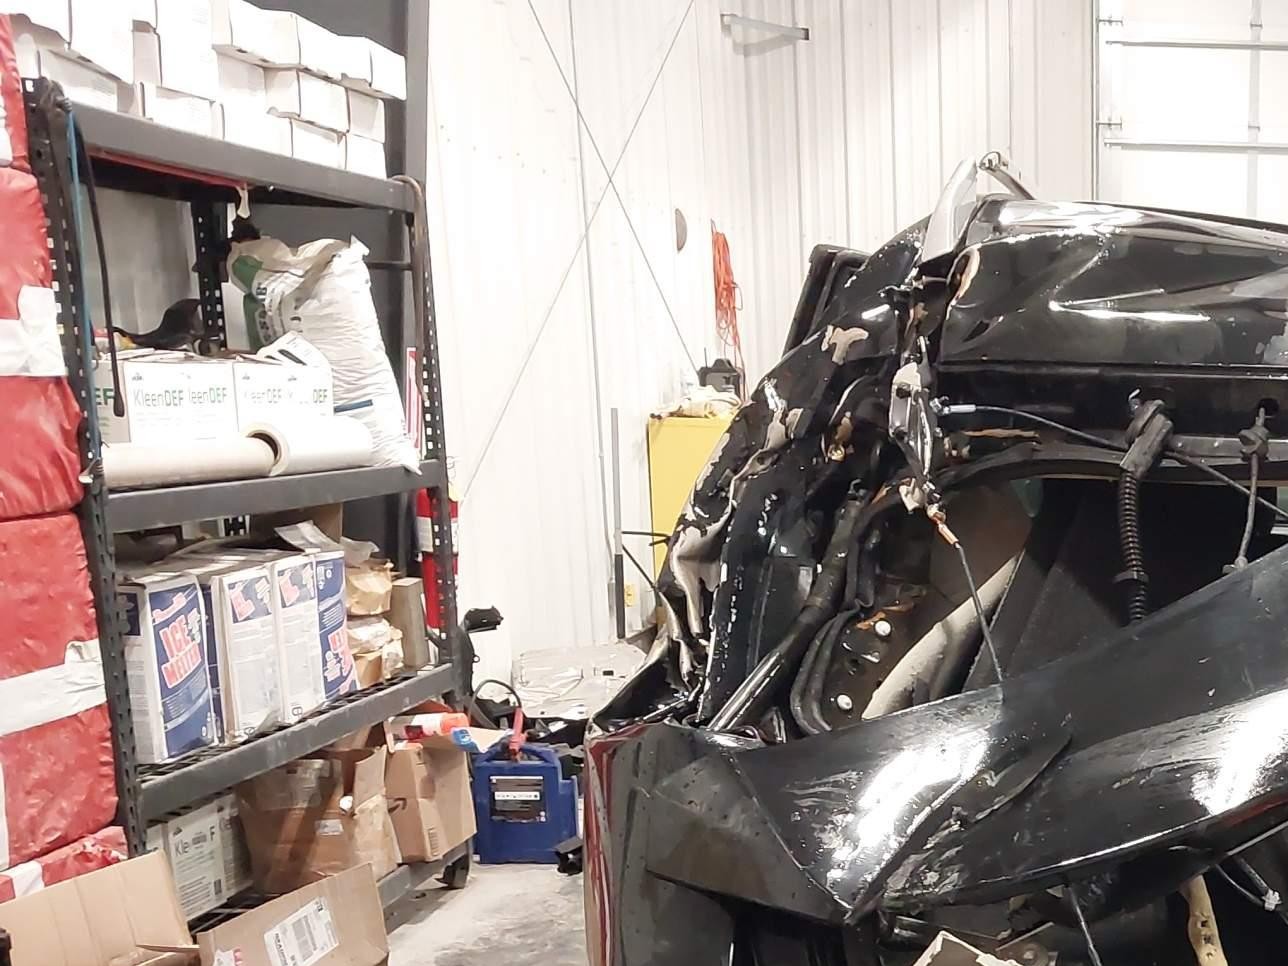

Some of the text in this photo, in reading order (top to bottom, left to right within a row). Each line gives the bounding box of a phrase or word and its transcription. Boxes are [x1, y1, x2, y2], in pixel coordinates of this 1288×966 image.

[133, 389, 184, 407] KleenDEF
[187, 387, 228, 404] leenDEF
[159, 613, 190, 663] ICE
